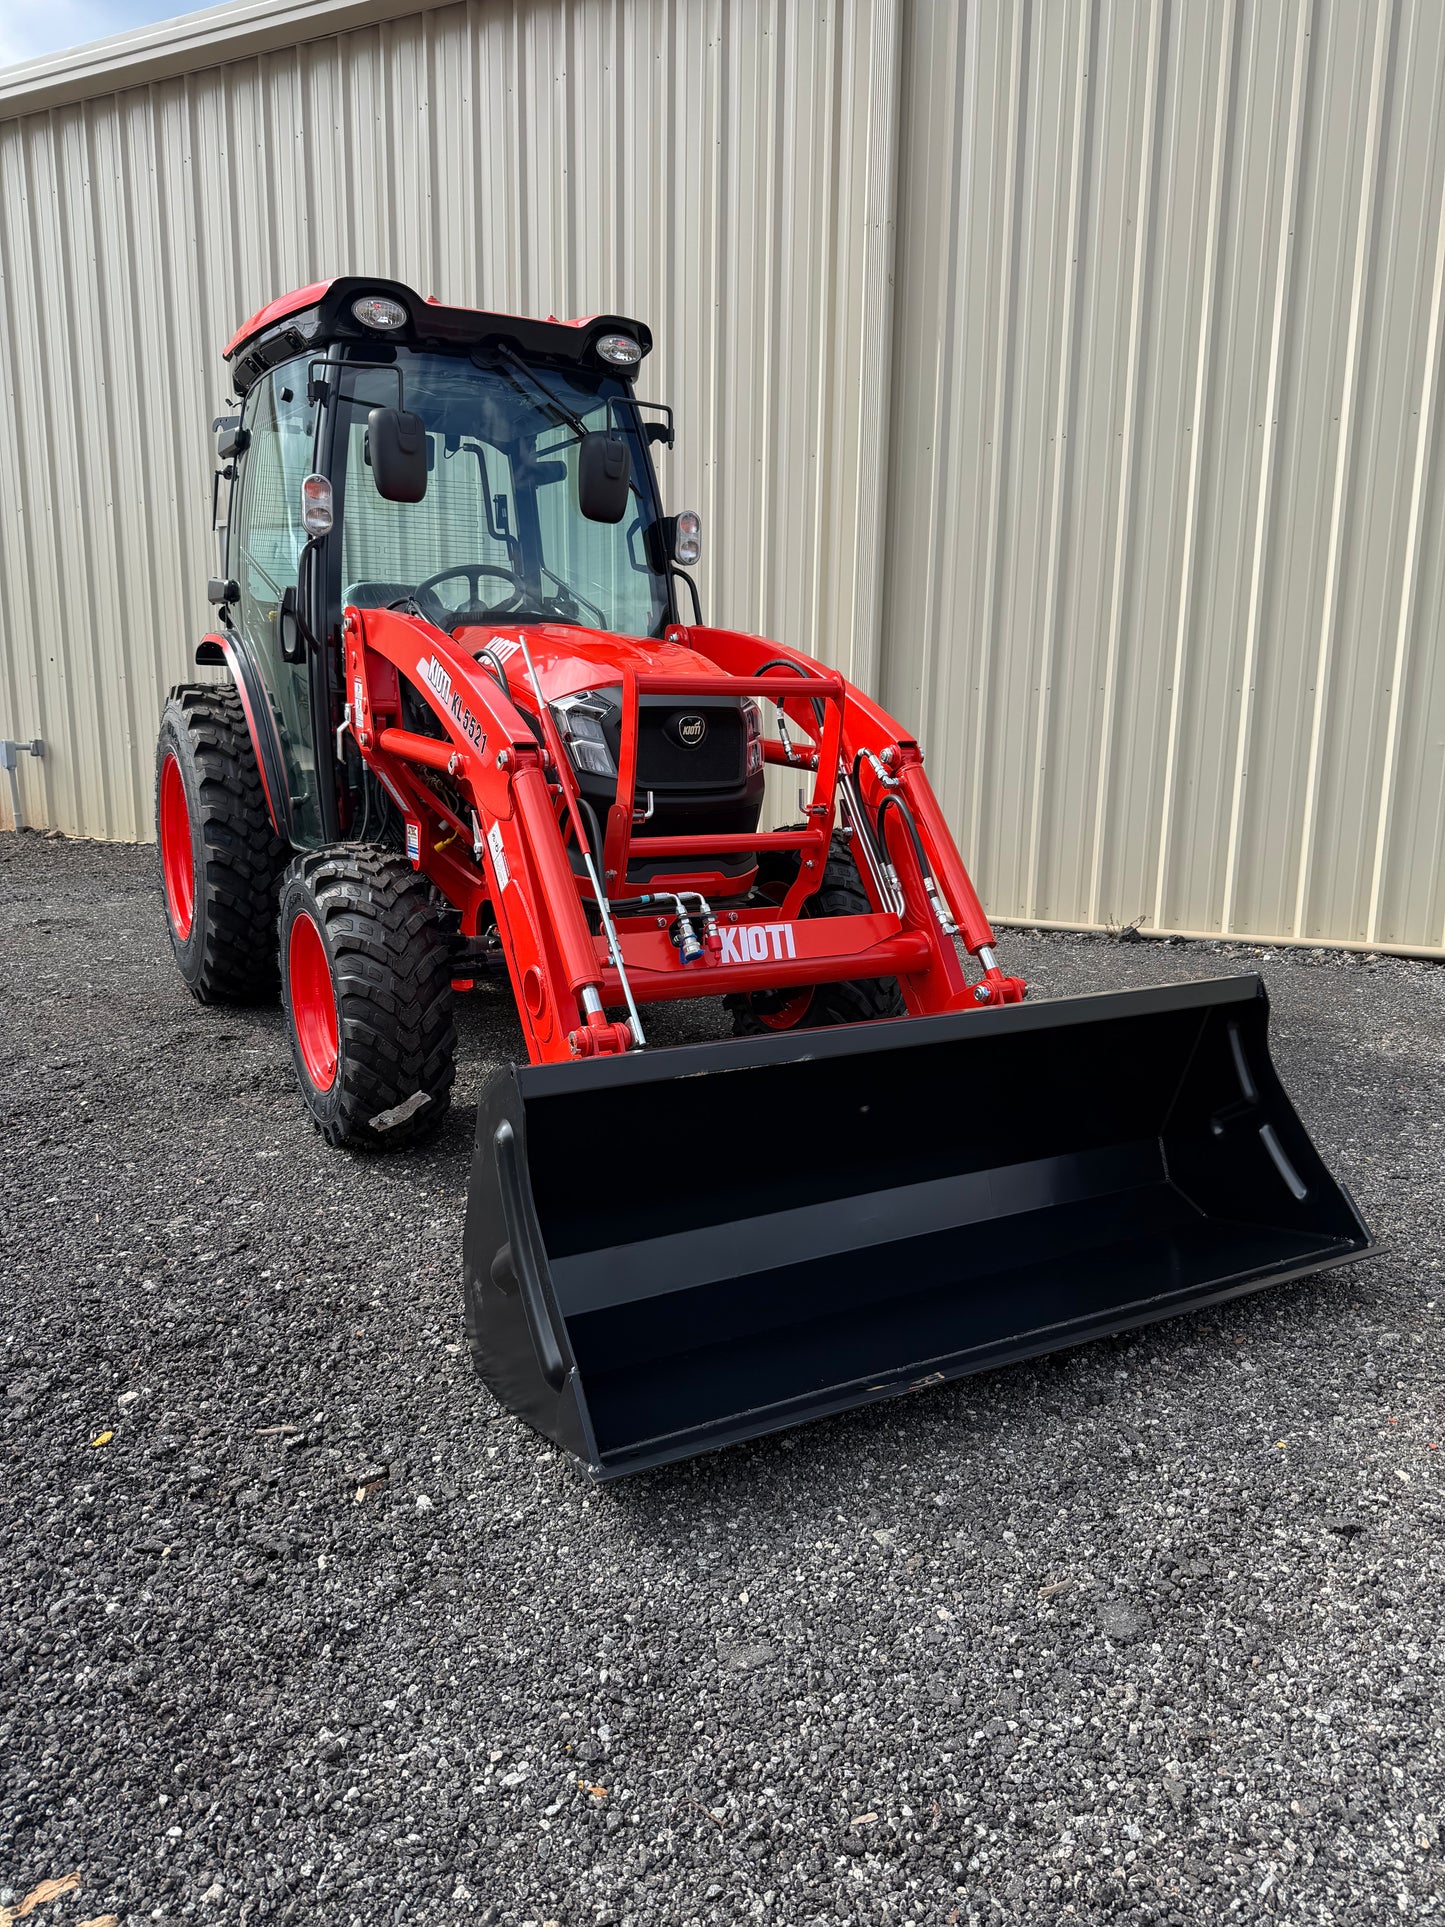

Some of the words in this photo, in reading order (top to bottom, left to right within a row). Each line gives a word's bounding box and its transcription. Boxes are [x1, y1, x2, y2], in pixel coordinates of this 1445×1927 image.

[477, 635, 522, 668] KIOTI
[427, 652, 453, 705] KIOTI
[451, 691, 463, 722] KL
[462, 708, 487, 754] 5521
[682, 725, 701, 735] KIOTI
[718, 923, 796, 963] KIOTI
